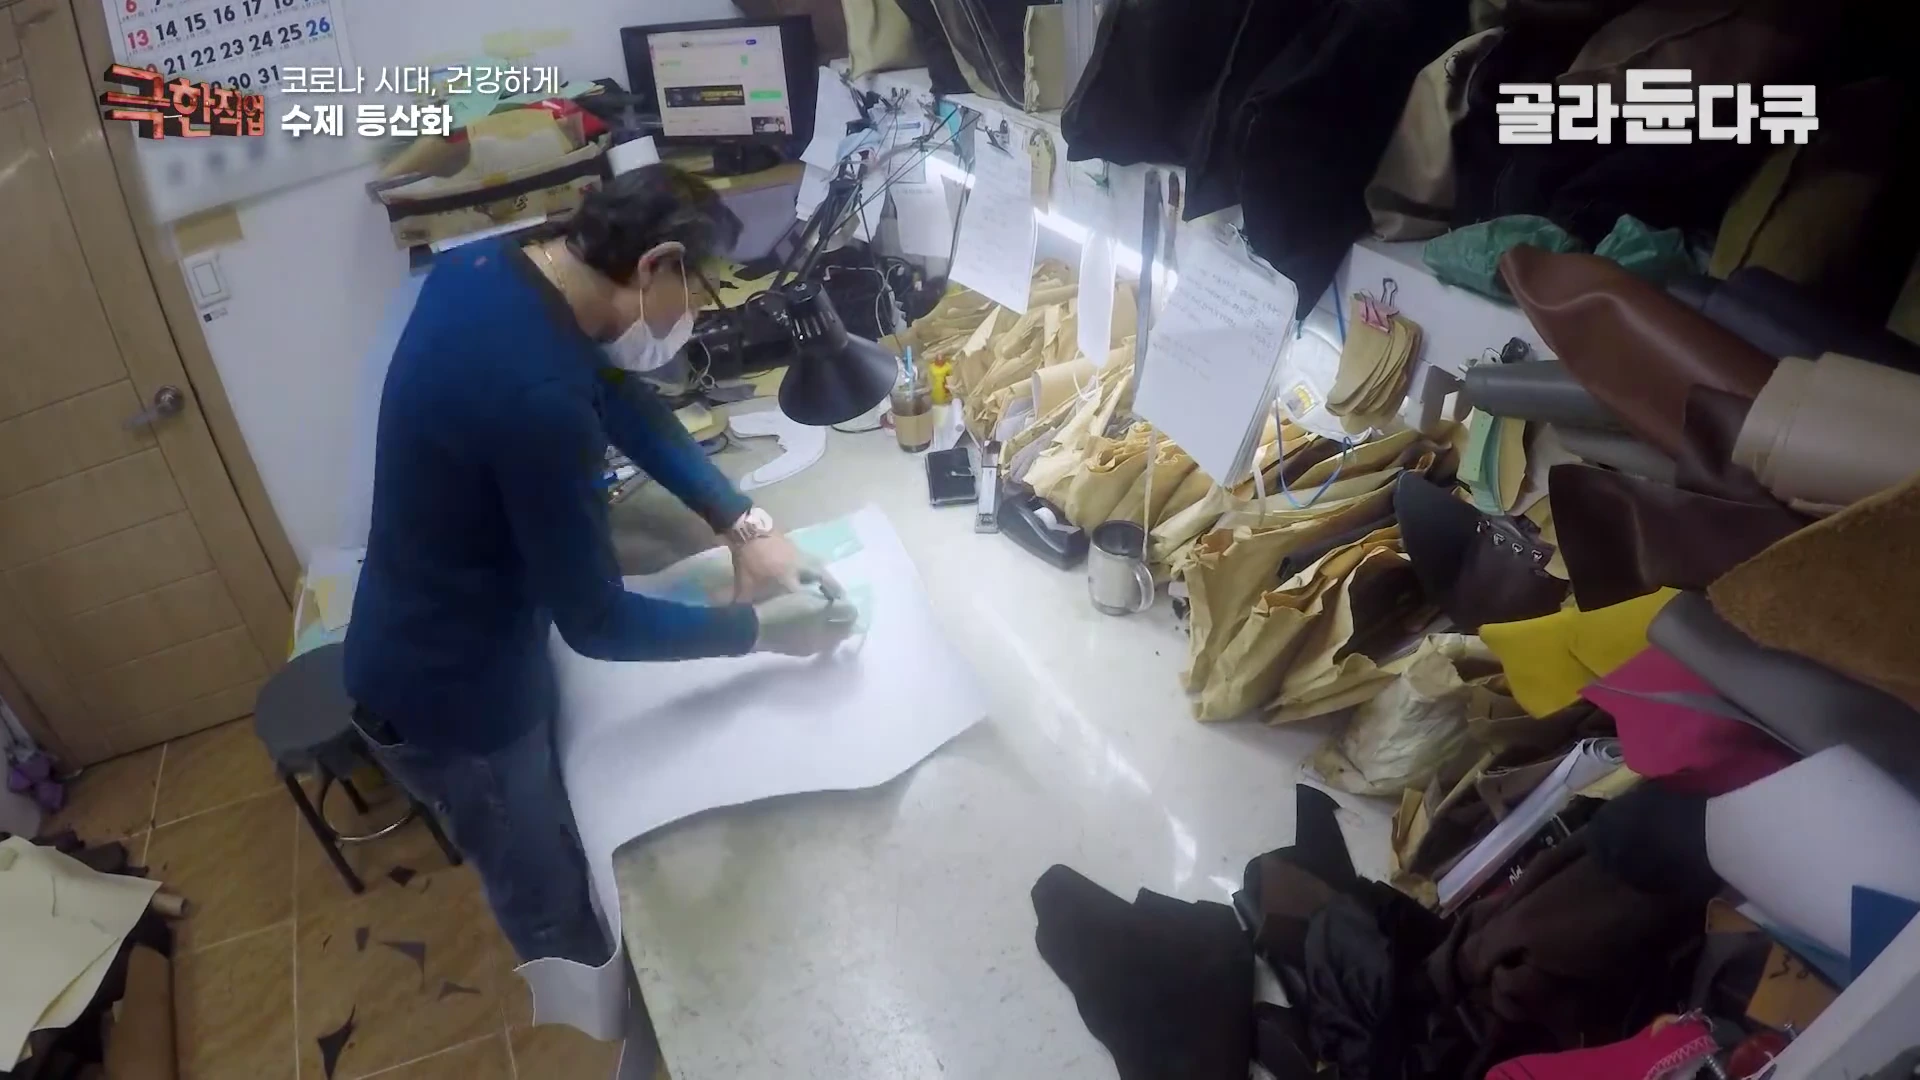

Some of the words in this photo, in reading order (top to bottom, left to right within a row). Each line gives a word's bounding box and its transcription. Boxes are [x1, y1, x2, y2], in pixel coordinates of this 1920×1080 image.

[126, 0, 137, 13] 6
[128, 29, 149, 49] 13
[155, 20, 178, 40] 14
[184, 13, 206, 32] 15
[213, 5, 235, 24] 16
[243, 0, 261, 16] 17
[164, 55, 186, 75] 21
[191, 46, 216, 67] 22
[220, 39, 244, 59] 23
[248, 30, 273, 51] 24
[278, 23, 302, 44] 25
[306, 16, 330, 37] 26
[227, 73, 251, 90] 30
[258, 65, 280, 84] 31
